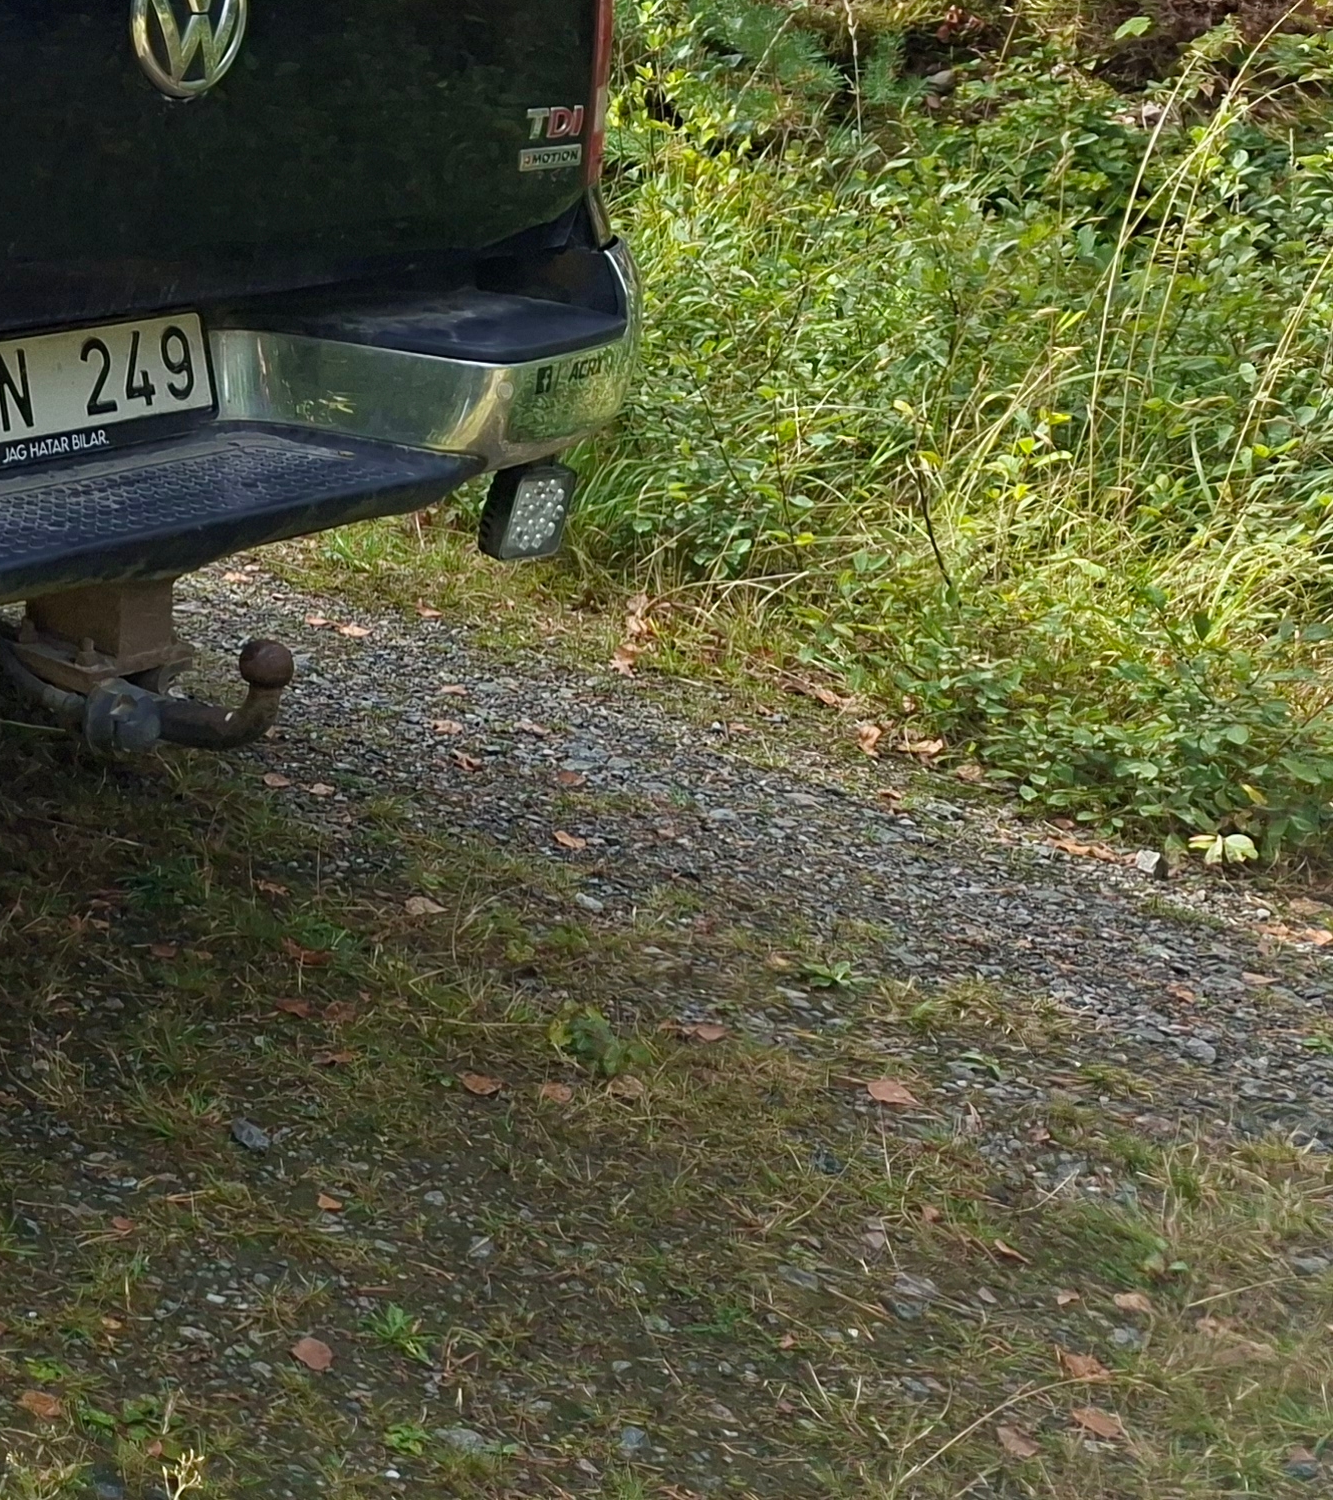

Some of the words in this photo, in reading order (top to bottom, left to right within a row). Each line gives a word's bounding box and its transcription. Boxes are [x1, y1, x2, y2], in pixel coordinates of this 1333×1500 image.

[526, 104, 584, 140] TDI
[79, 325, 196, 417] 249
[2, 444, 28, 465] JAG
[29, 436, 71, 460] HATAR
[71, 429, 111, 451] BILAR.
